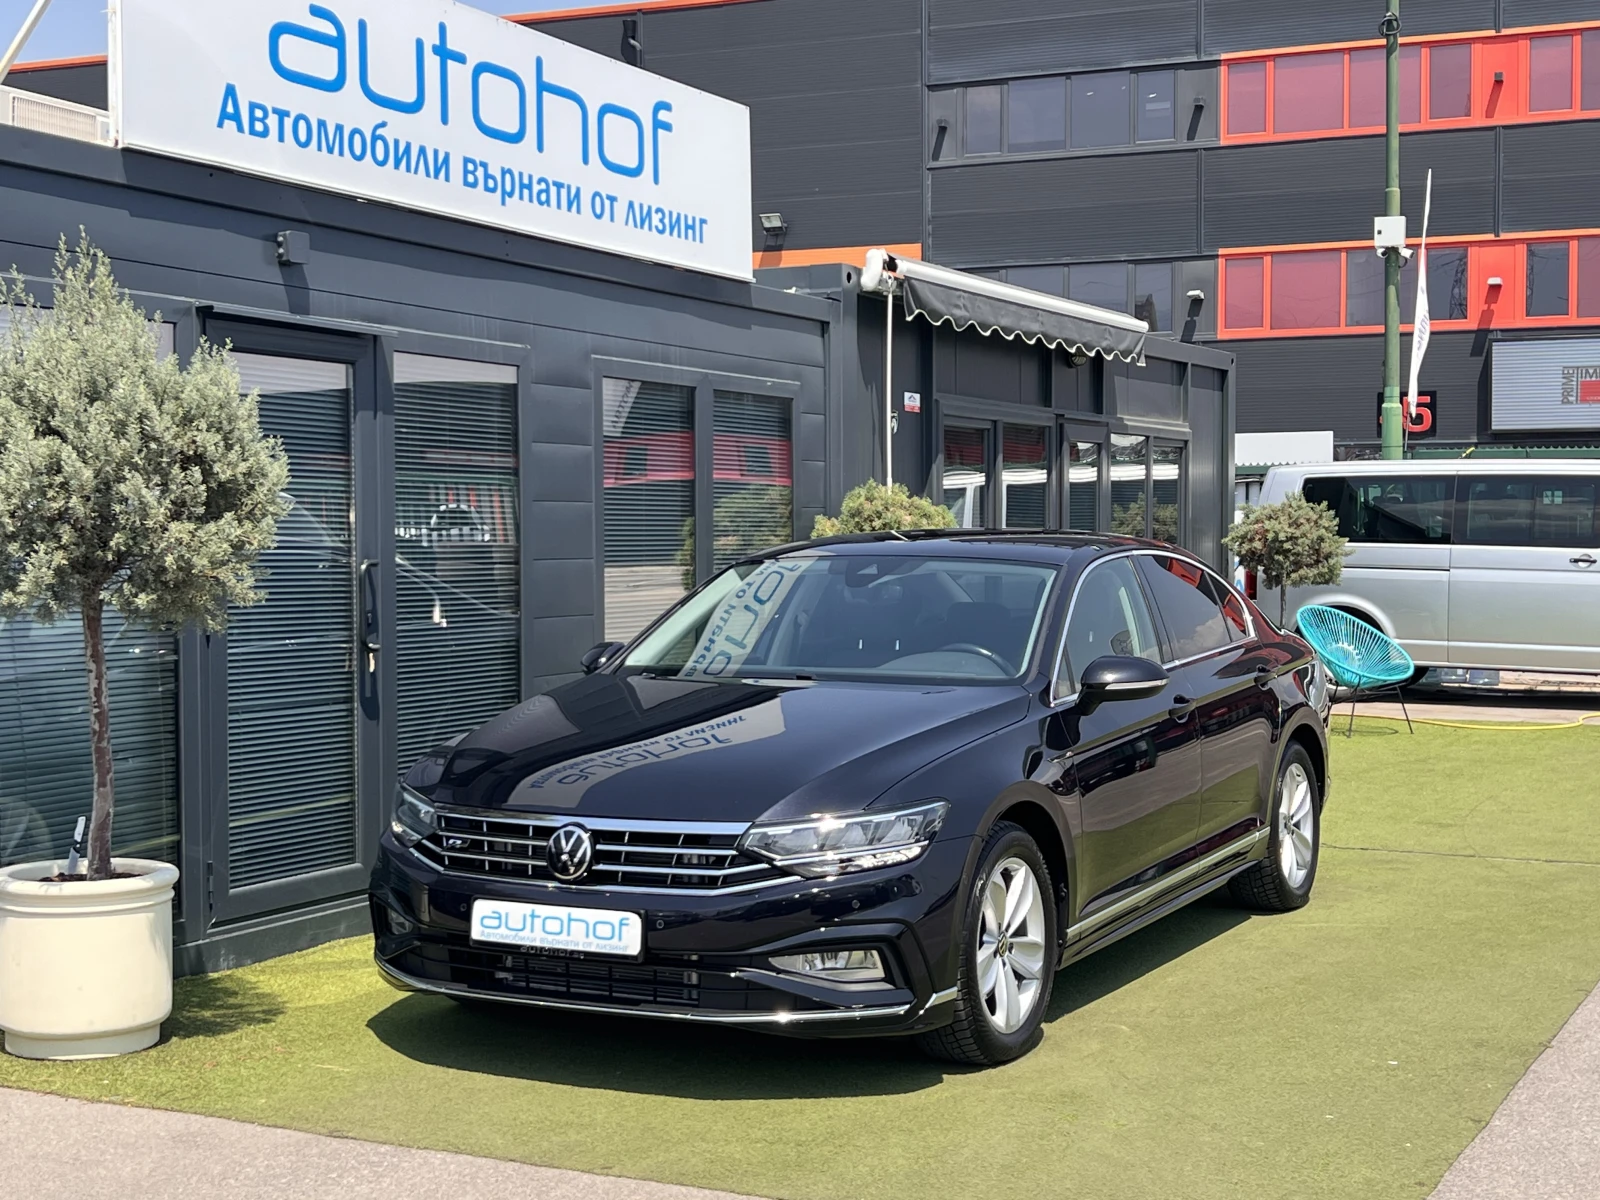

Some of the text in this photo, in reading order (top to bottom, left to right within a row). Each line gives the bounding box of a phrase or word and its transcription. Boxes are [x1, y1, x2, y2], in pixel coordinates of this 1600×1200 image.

[268, 3, 673, 186] autohof
[216, 82, 708, 244] Автомобили върнати от лизинг
[1561, 368, 1575, 404] PRIME
[1580, 367, 1600, 380] IM
[480, 908, 630, 942] autohof
[480, 929, 538, 944] Автомобили
[540, 937, 580, 949] върнати
[582, 941, 594, 950] от
